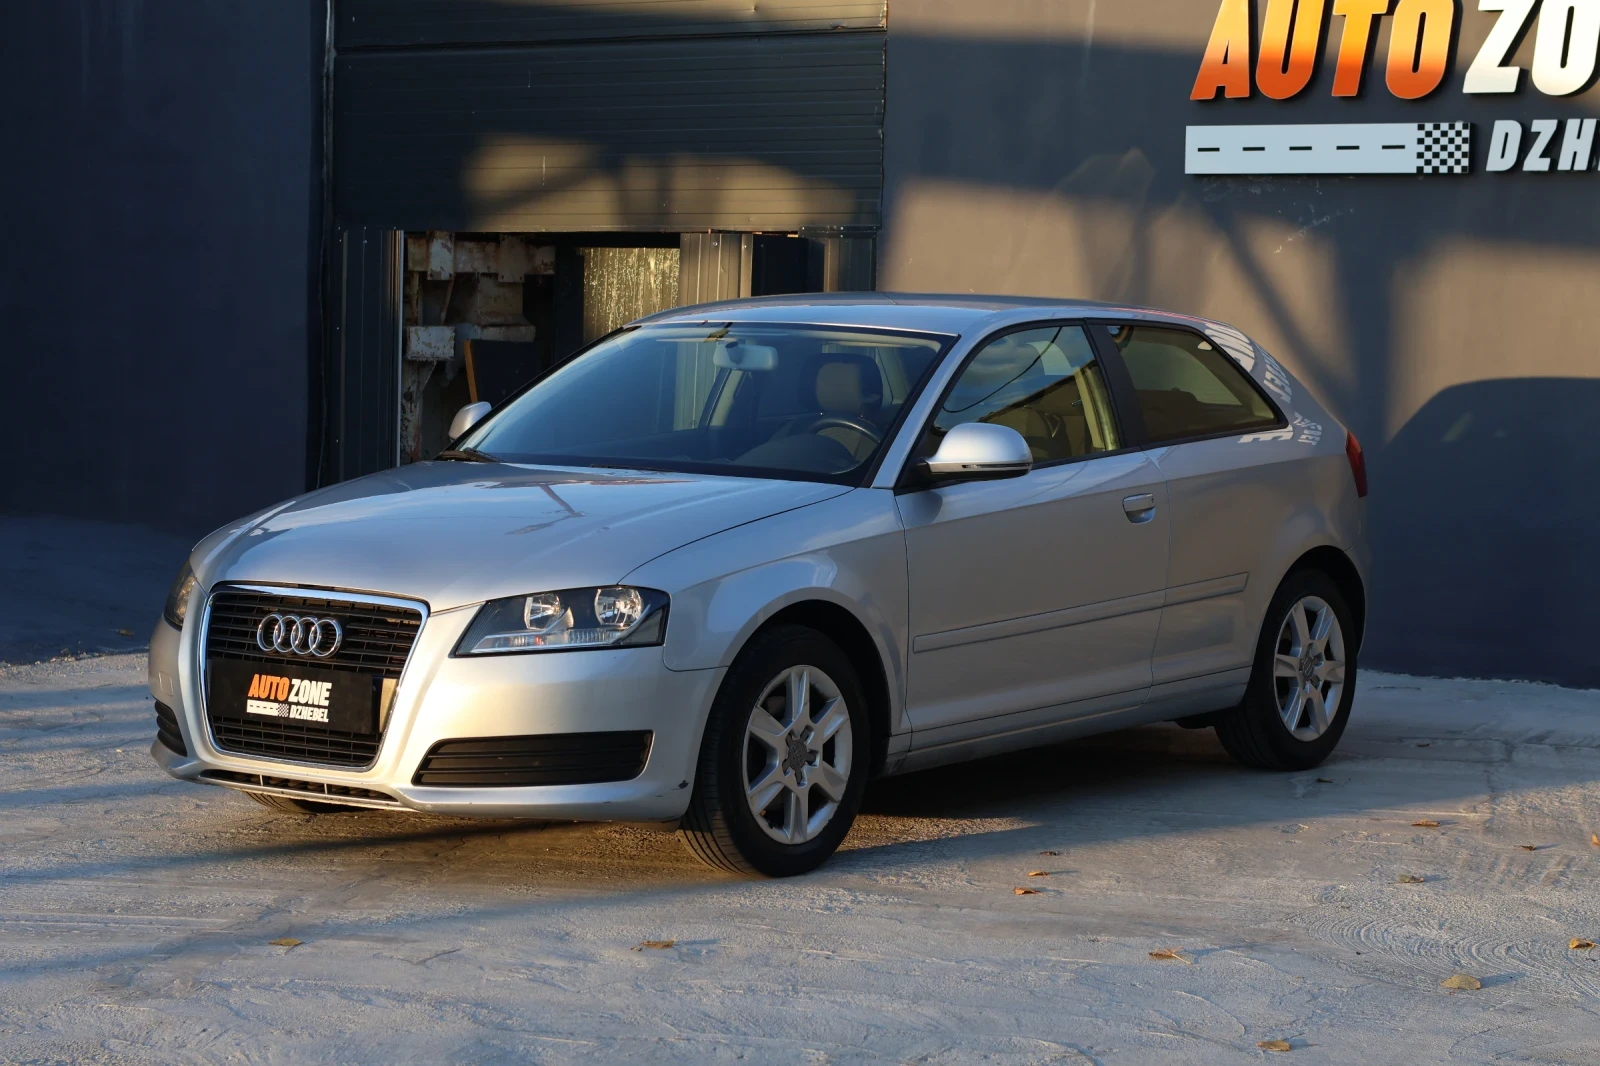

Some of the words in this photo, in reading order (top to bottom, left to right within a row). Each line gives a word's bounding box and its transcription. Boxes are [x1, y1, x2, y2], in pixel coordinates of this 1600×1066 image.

[1190, 0, 1454, 100] AUTO
[1486, 118, 1600, 172] DZH
[247, 673, 290, 701] AUTO
[288, 678, 333, 706] ZONE
[289, 704, 329, 723] DZHEBEL
